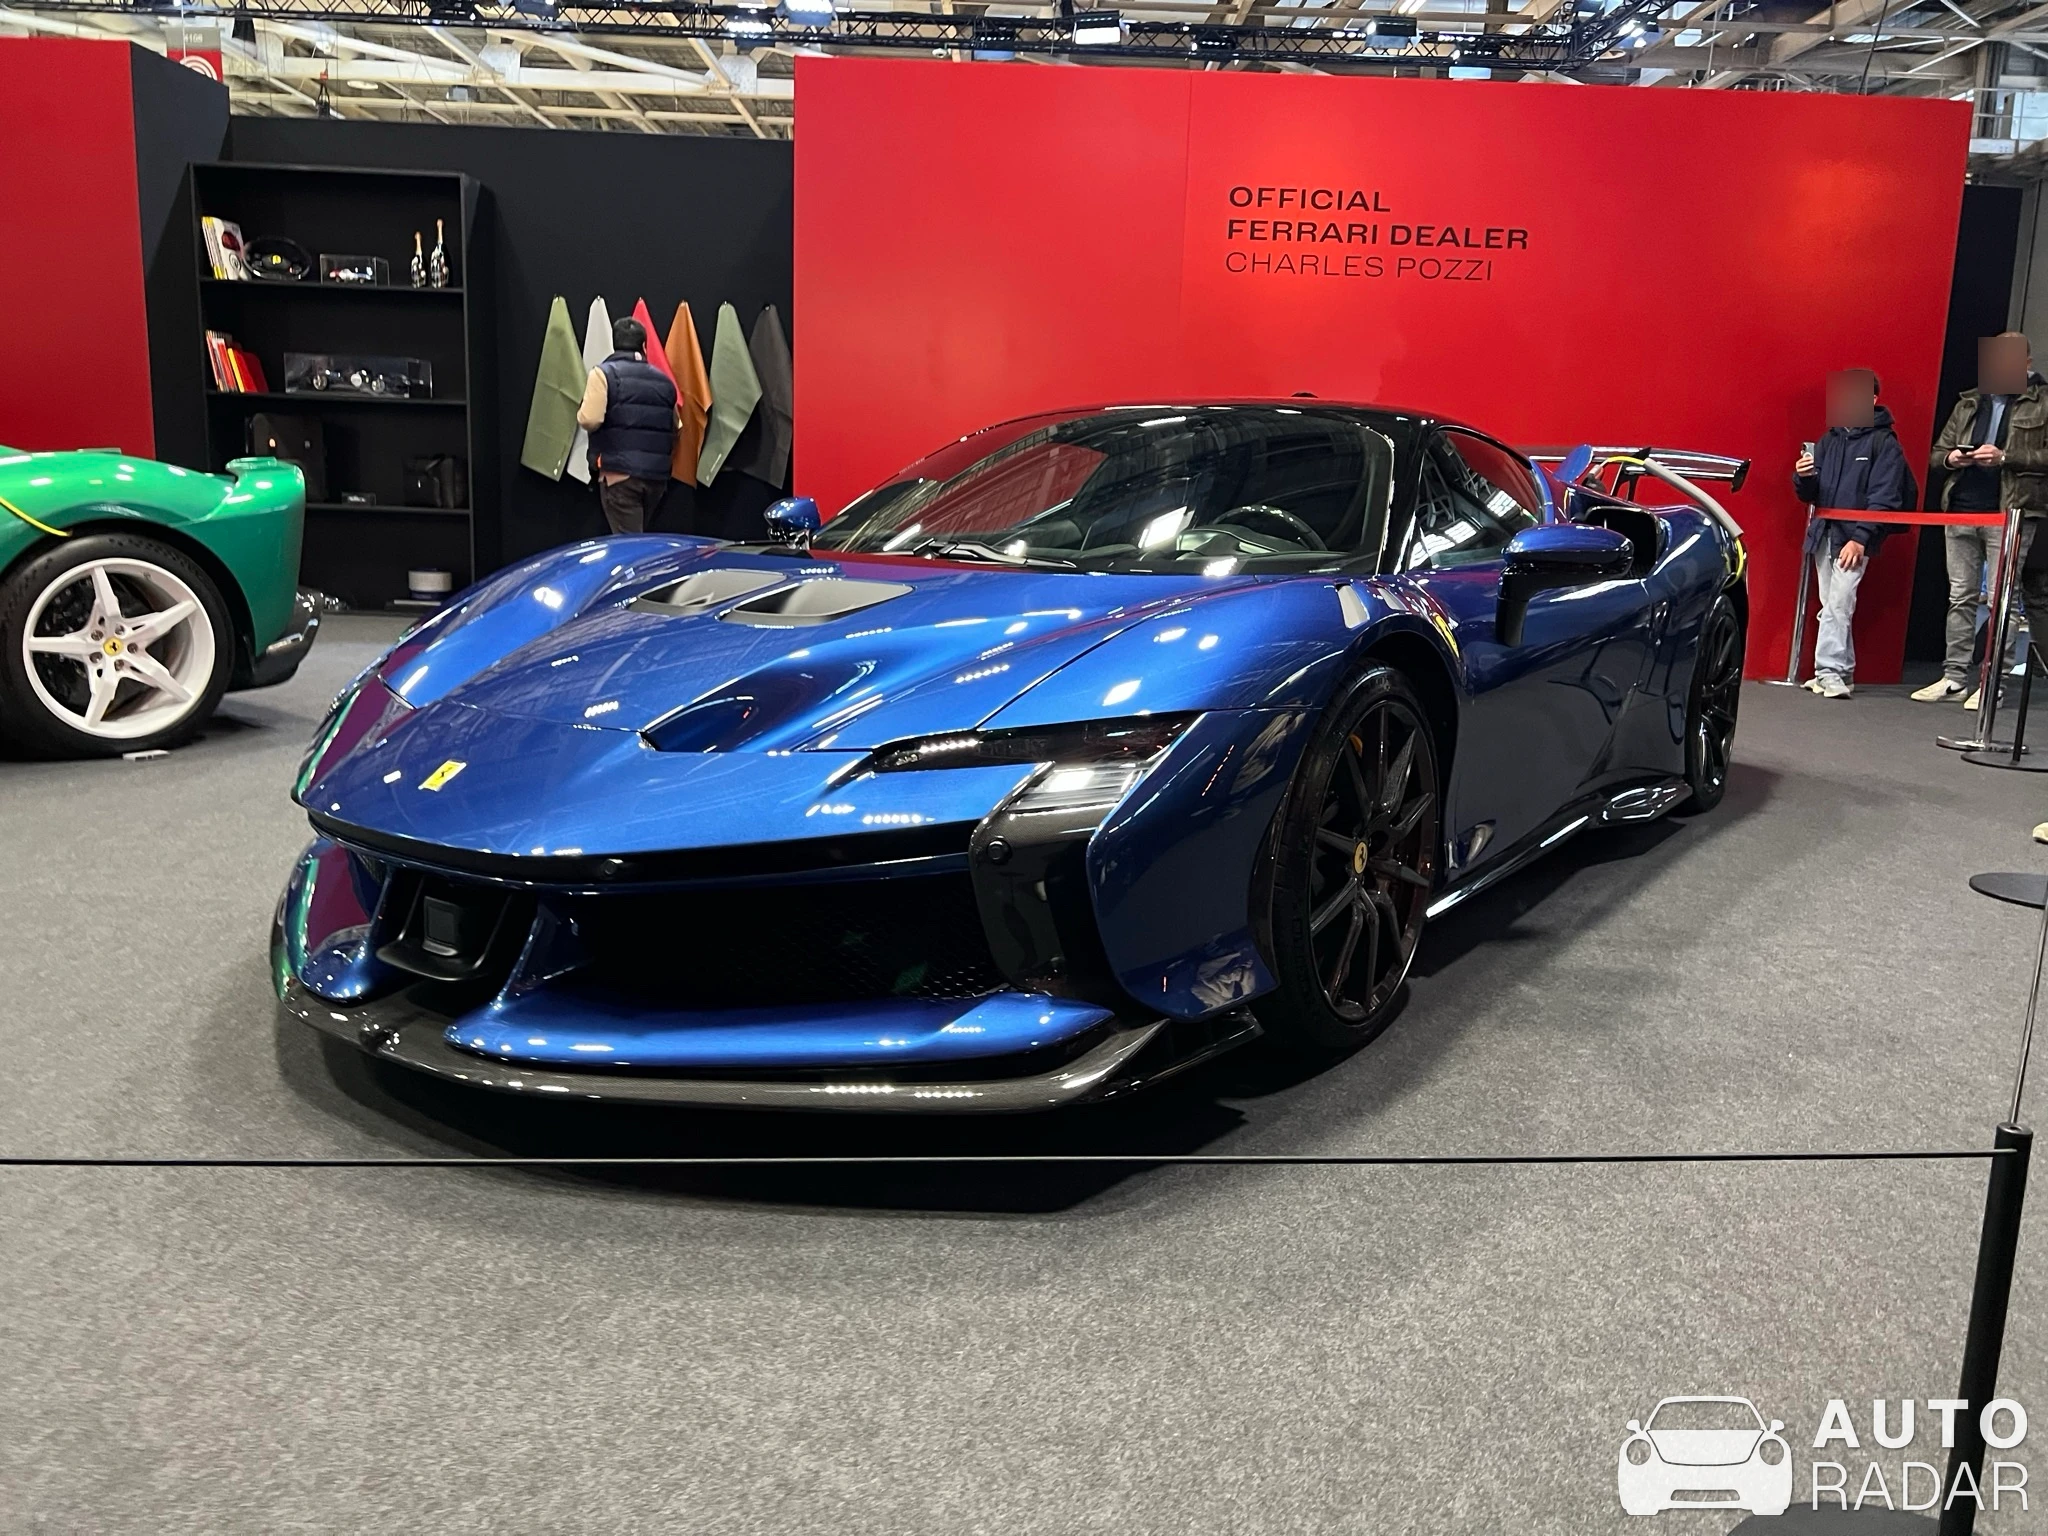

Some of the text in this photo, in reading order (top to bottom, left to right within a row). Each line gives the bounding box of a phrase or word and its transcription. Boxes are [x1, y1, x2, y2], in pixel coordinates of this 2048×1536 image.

[1229, 186, 1391, 212] OFFICIAL
[1227, 219, 1529, 250] FERRARI DEALER
[1225, 252, 1492, 281] CHARLES POZZI
